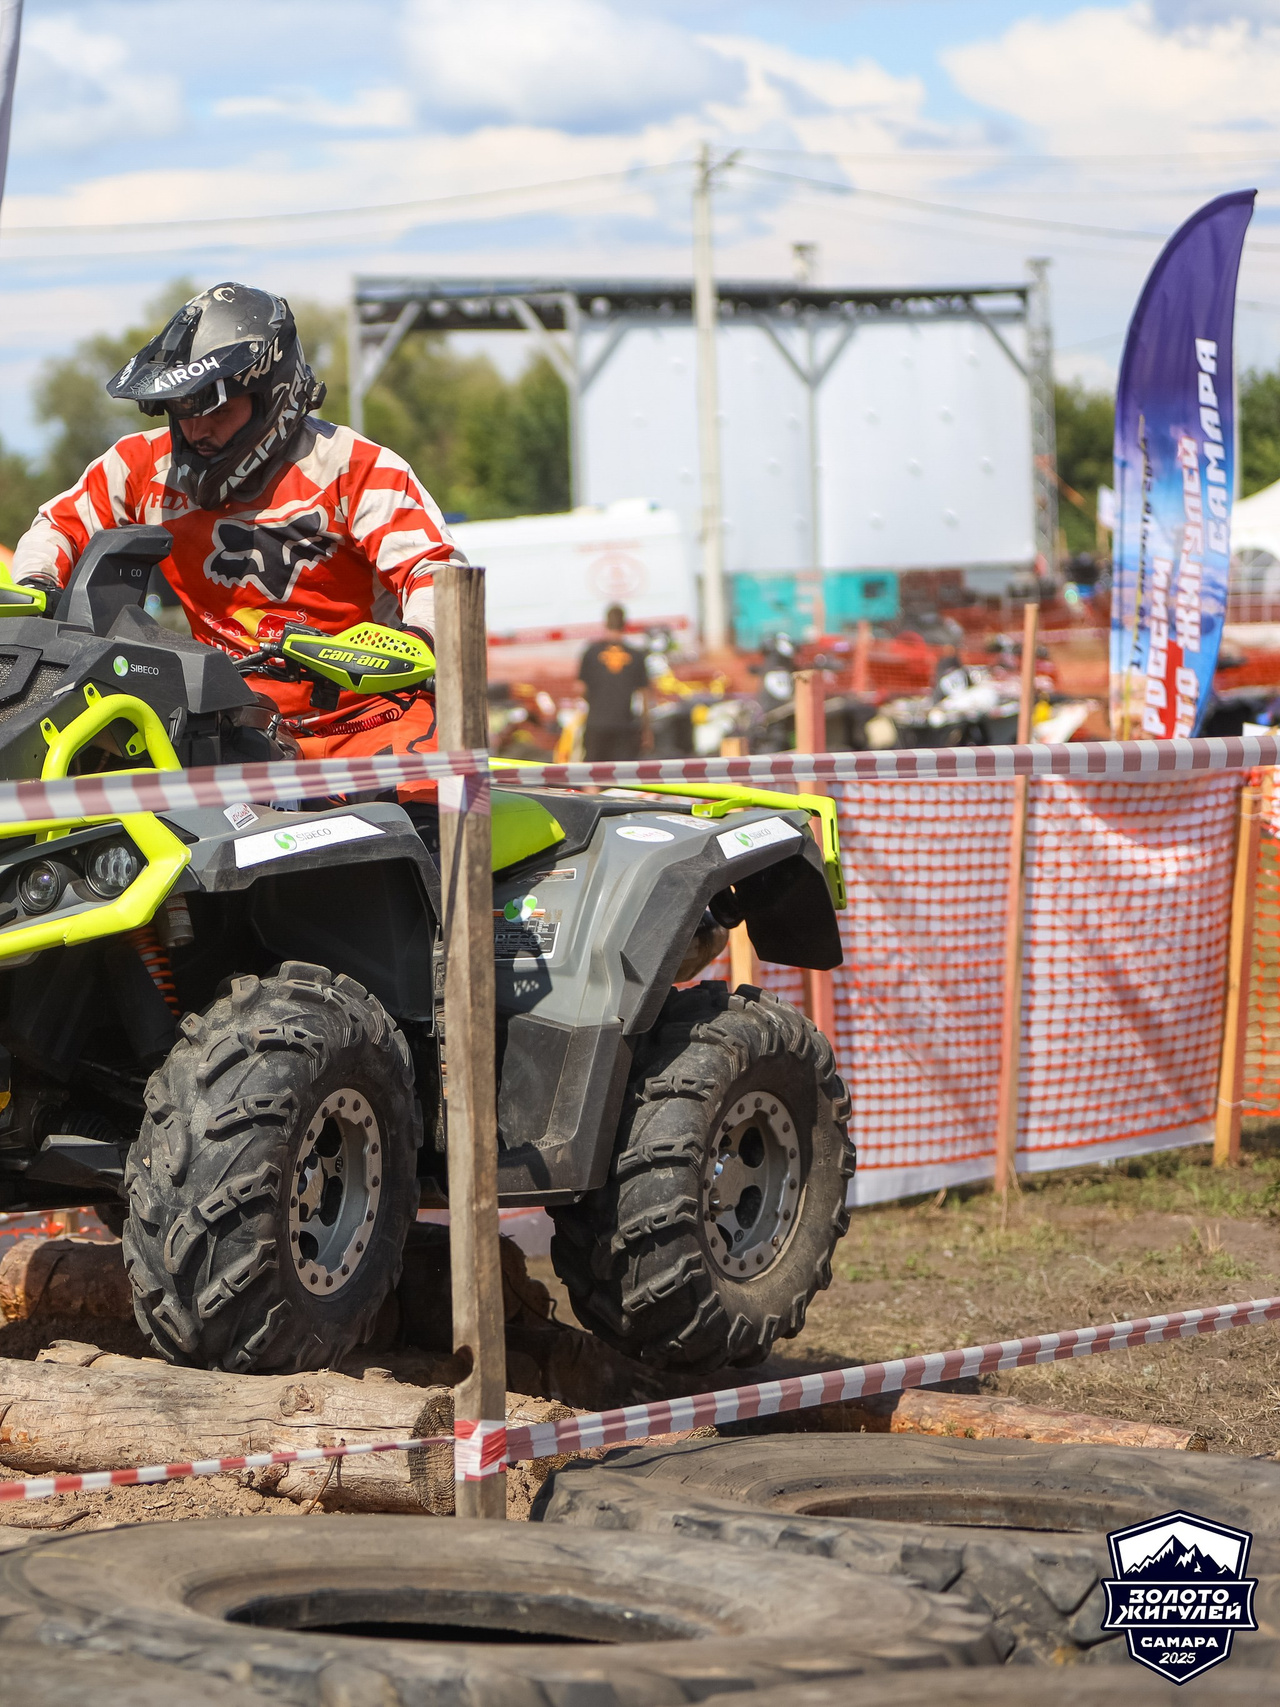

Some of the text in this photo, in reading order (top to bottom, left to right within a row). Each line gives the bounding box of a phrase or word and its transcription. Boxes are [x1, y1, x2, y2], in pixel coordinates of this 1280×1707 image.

[154, 356, 221, 393] AIROH
[1195, 337, 1229, 555] САМАРА
[150, 492, 189, 511] FOX
[1176, 435, 1204, 653] ЖИГУЛЕЙ
[1143, 557, 1173, 737] РОССИИ
[130, 663, 160, 676] SIBECO
[318, 648, 391, 671] can-am
[295, 828, 332, 842] SIBECO
[495, 932, 541, 947] BECO
